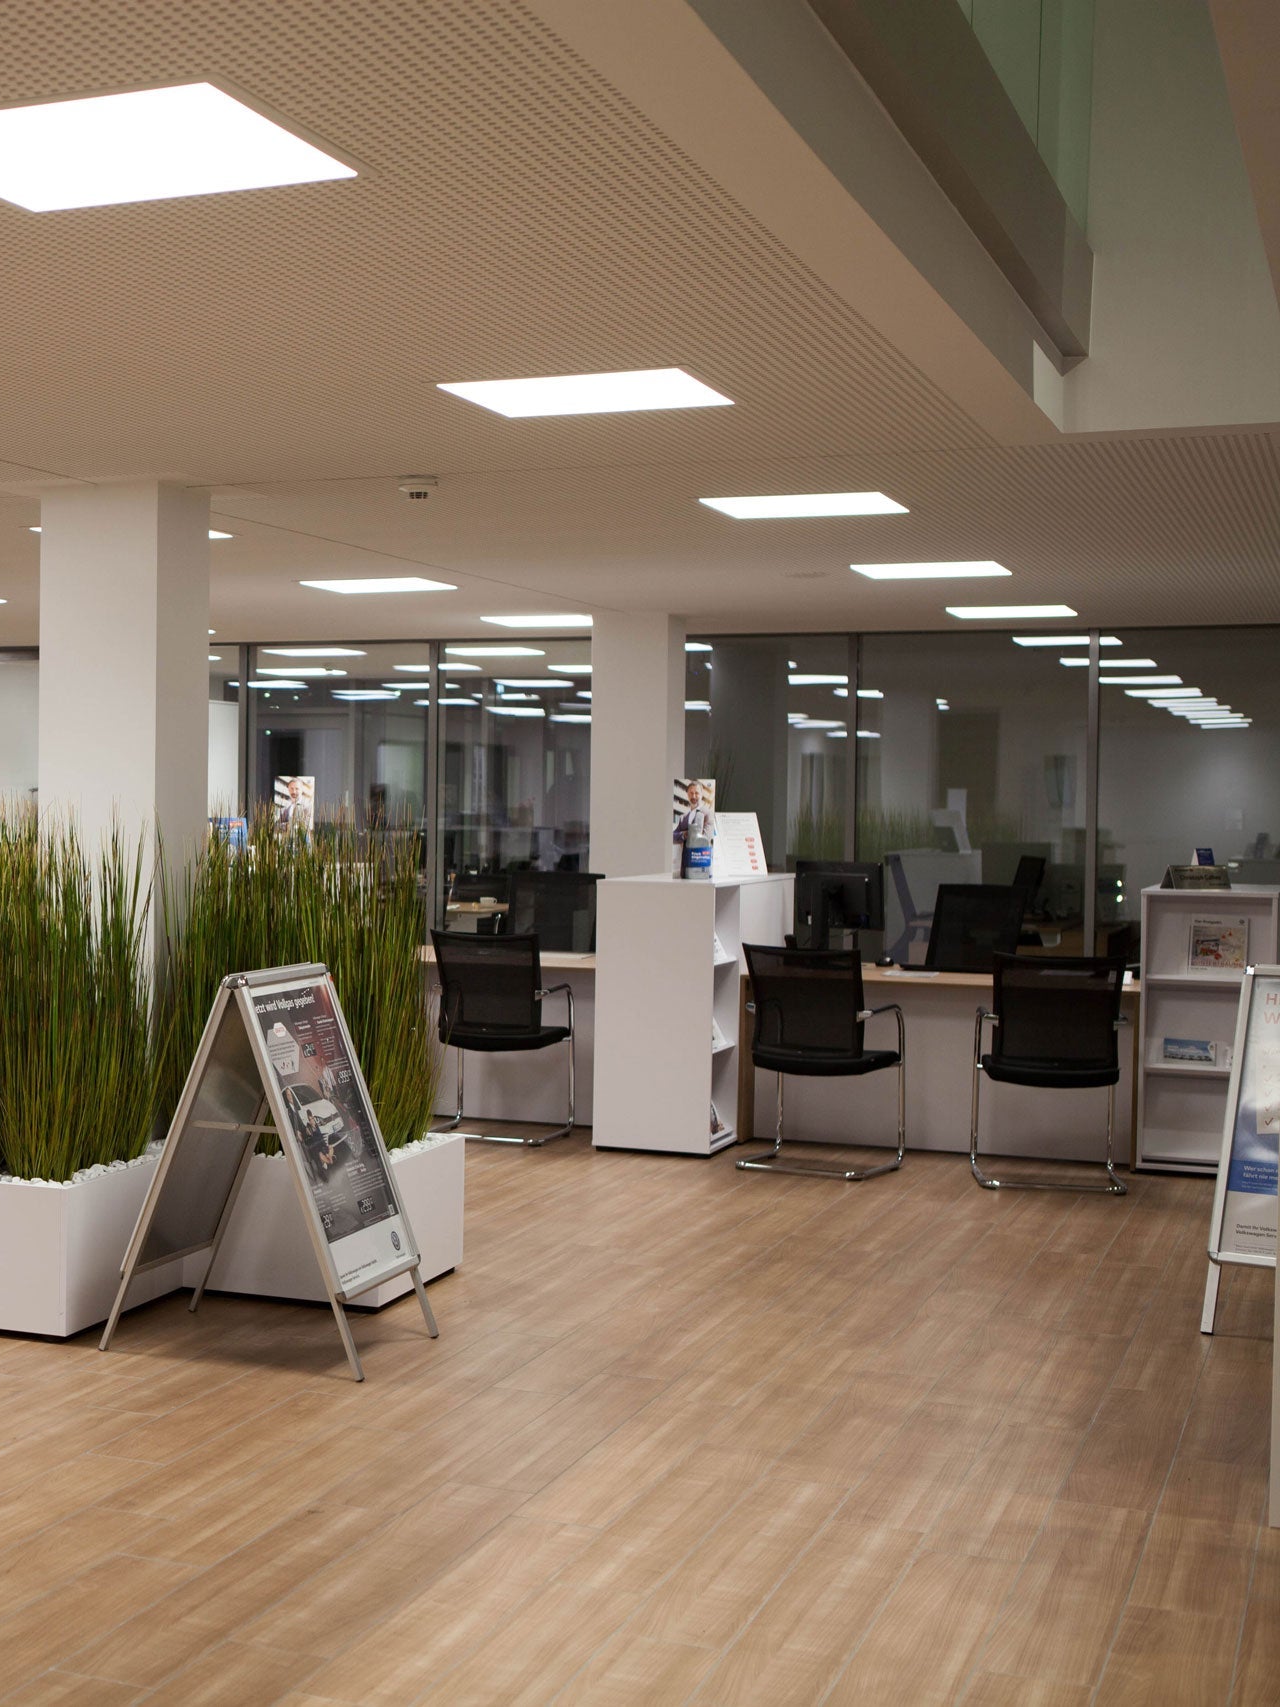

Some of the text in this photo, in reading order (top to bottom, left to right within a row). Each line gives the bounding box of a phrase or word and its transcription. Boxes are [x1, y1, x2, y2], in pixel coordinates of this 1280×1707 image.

[255, 995, 315, 1014] etzt wird Vollgas gegeben!
[1266, 992, 1280, 1005] H
[1235, 1229, 1265, 1237] Volkswagen
